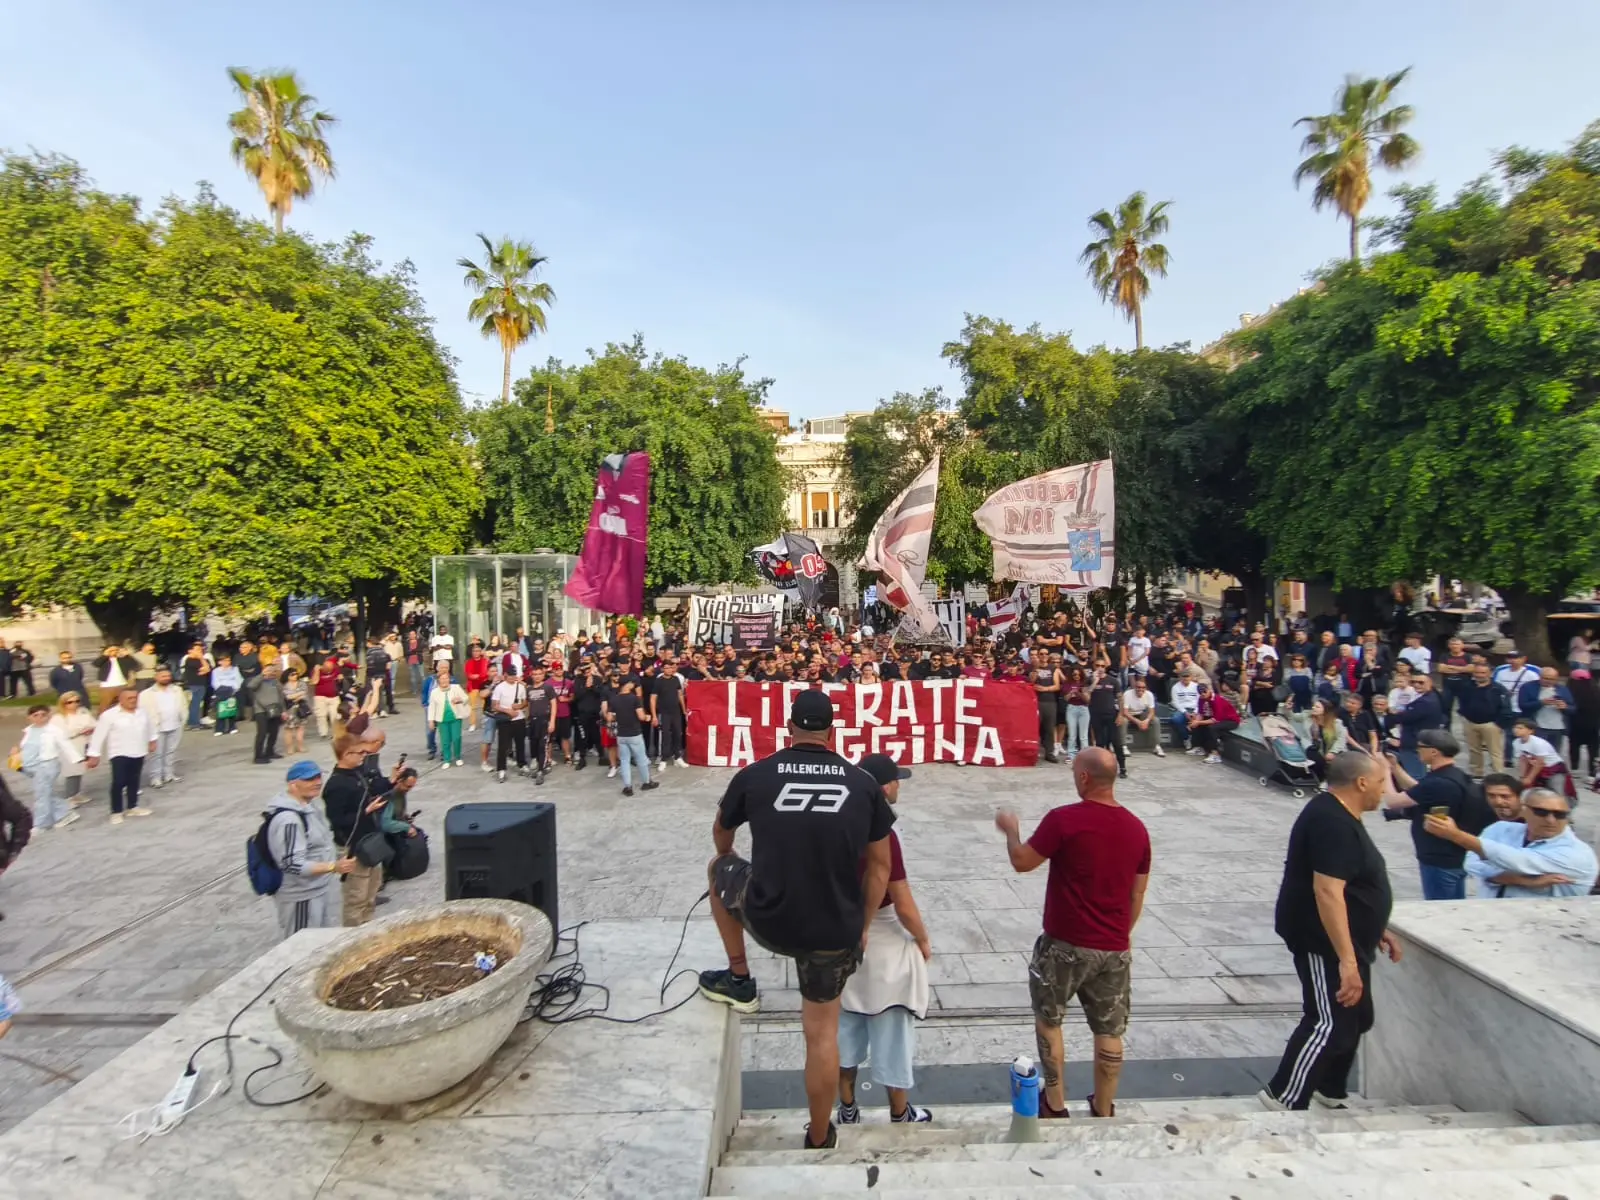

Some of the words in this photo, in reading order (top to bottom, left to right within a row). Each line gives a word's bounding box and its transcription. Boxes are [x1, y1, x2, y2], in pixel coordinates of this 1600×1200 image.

[707, 724, 756, 767] LA
[777, 762, 846, 777] BALENCIAGA
[773, 782, 850, 813] 63
